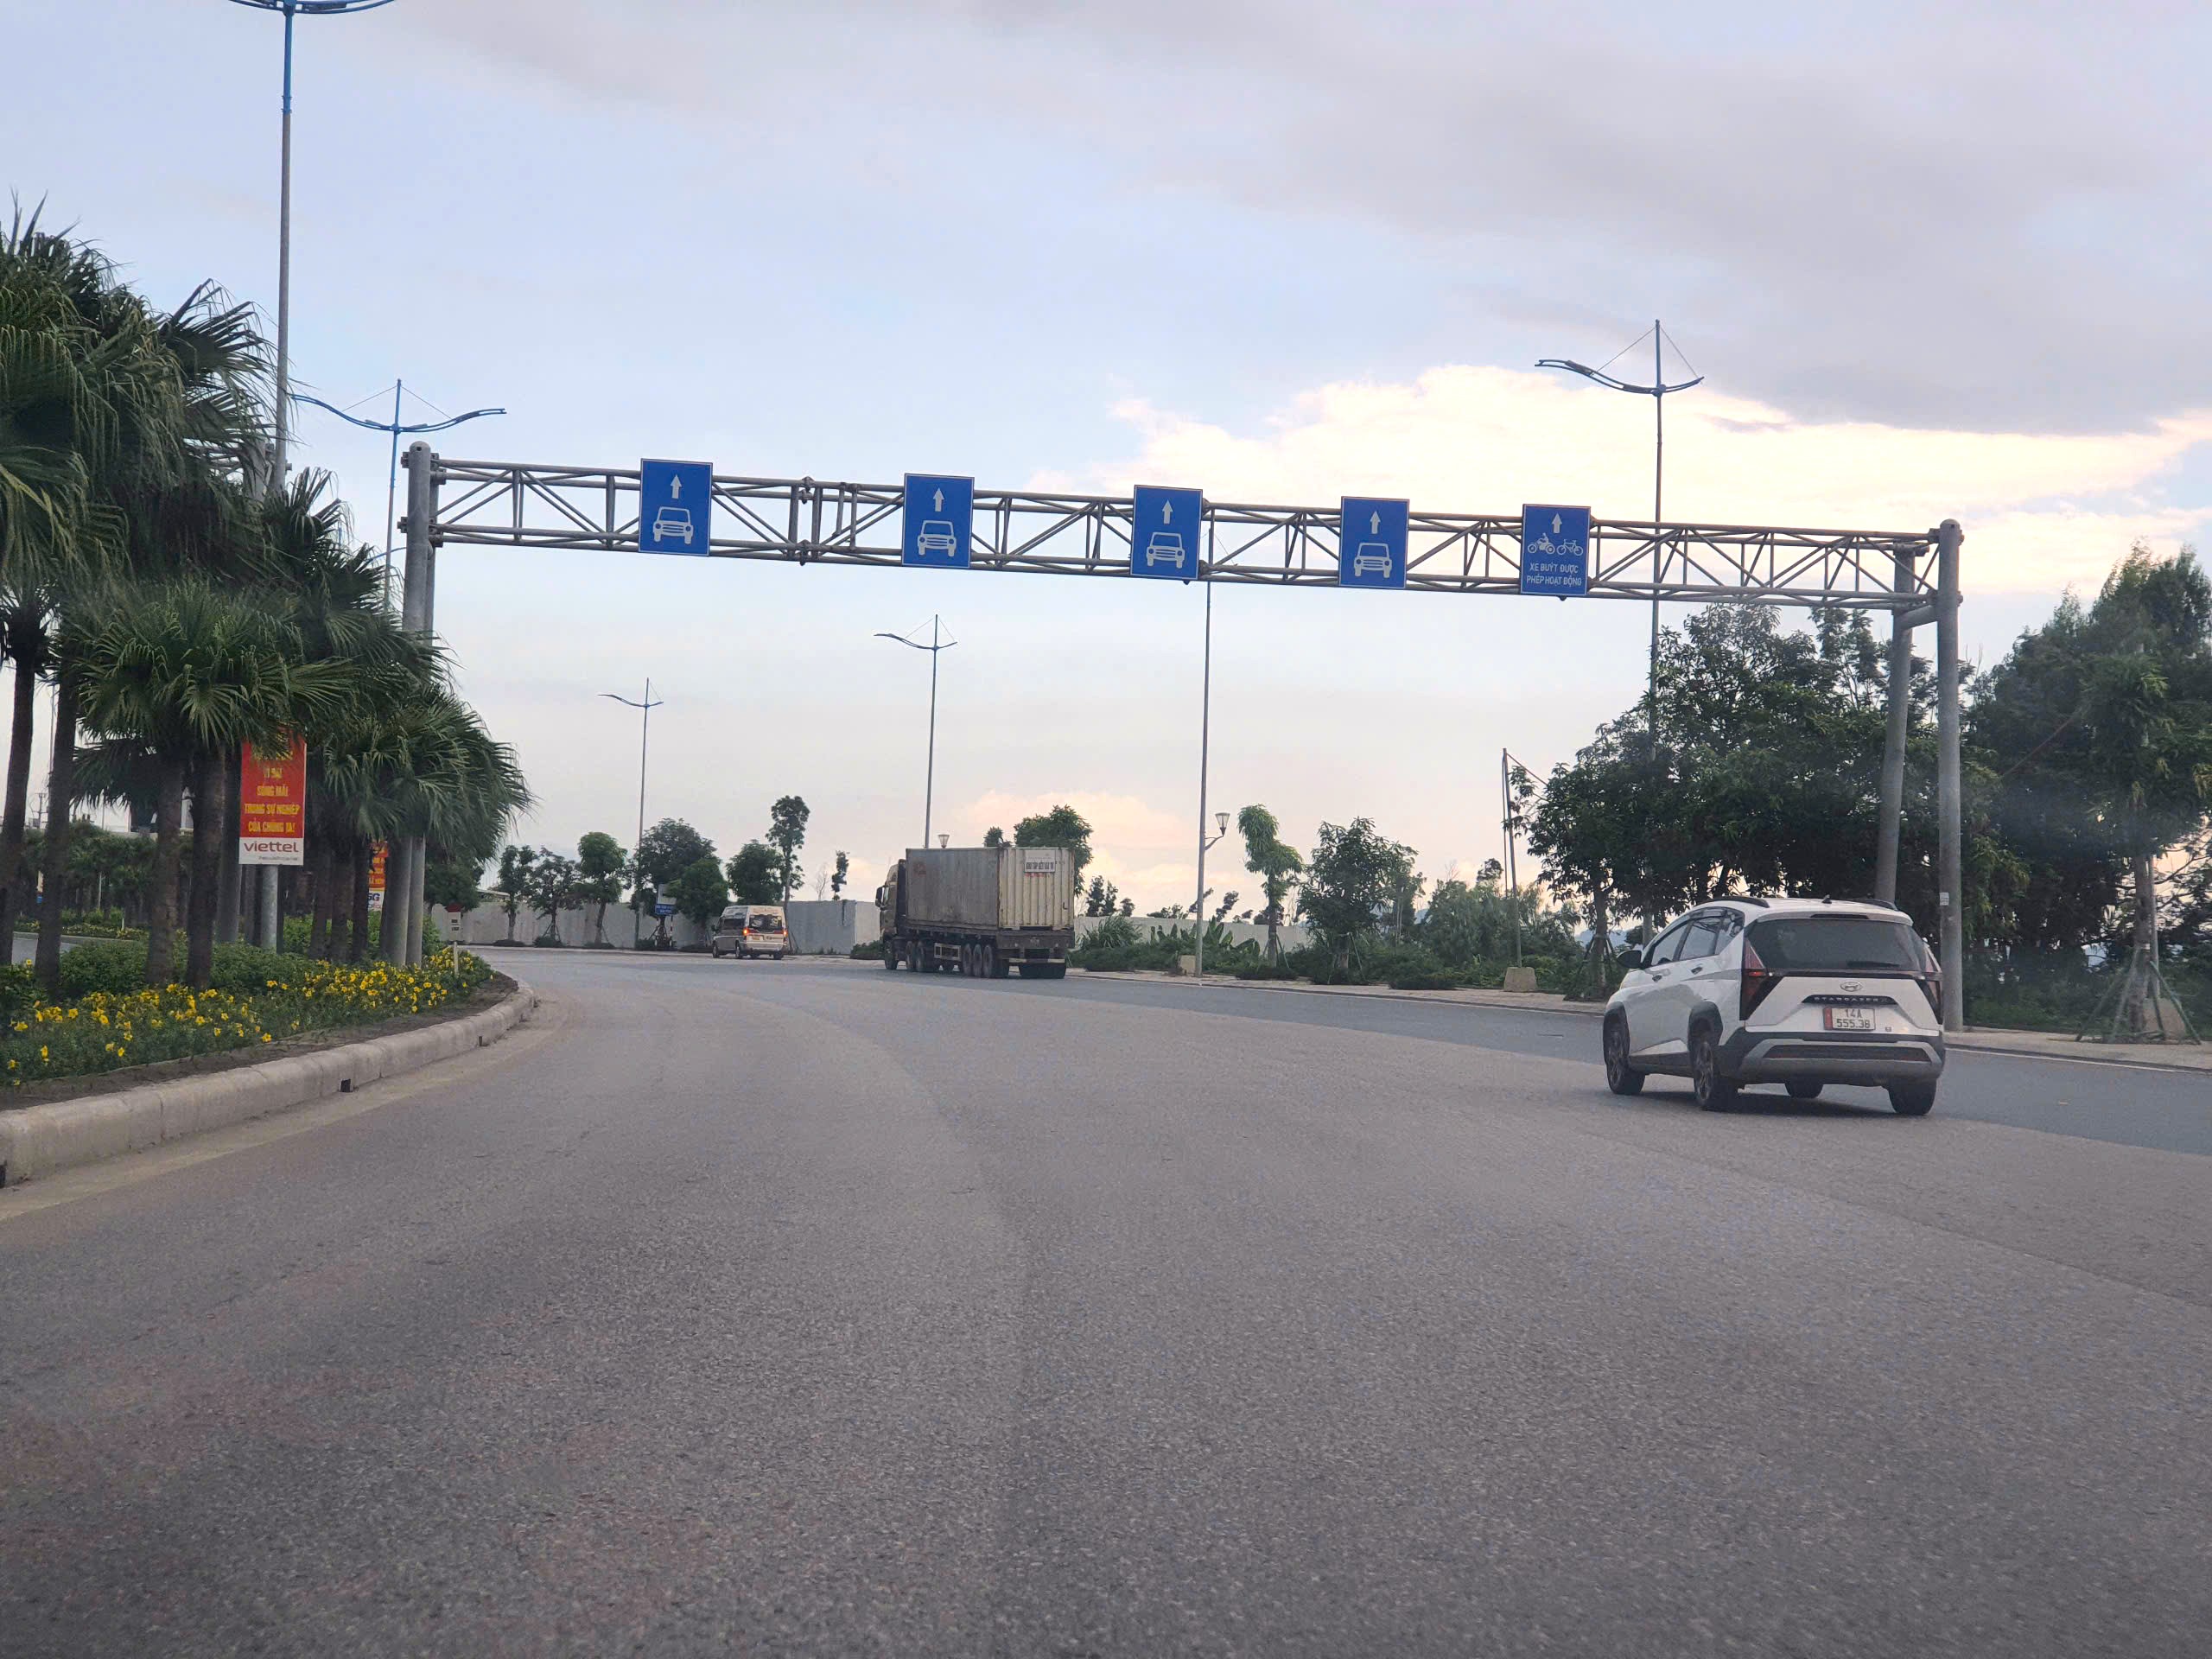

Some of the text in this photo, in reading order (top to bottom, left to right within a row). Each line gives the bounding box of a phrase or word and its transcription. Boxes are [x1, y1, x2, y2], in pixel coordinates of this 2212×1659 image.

[1529, 562, 1579, 575] XE BUÝT ĐƯỢC
[1526, 574, 1582, 588] PHÉP HOẠT ĐỘNG
[244, 841, 299, 853] viettel
[1845, 1008, 1862, 1019] 14A
